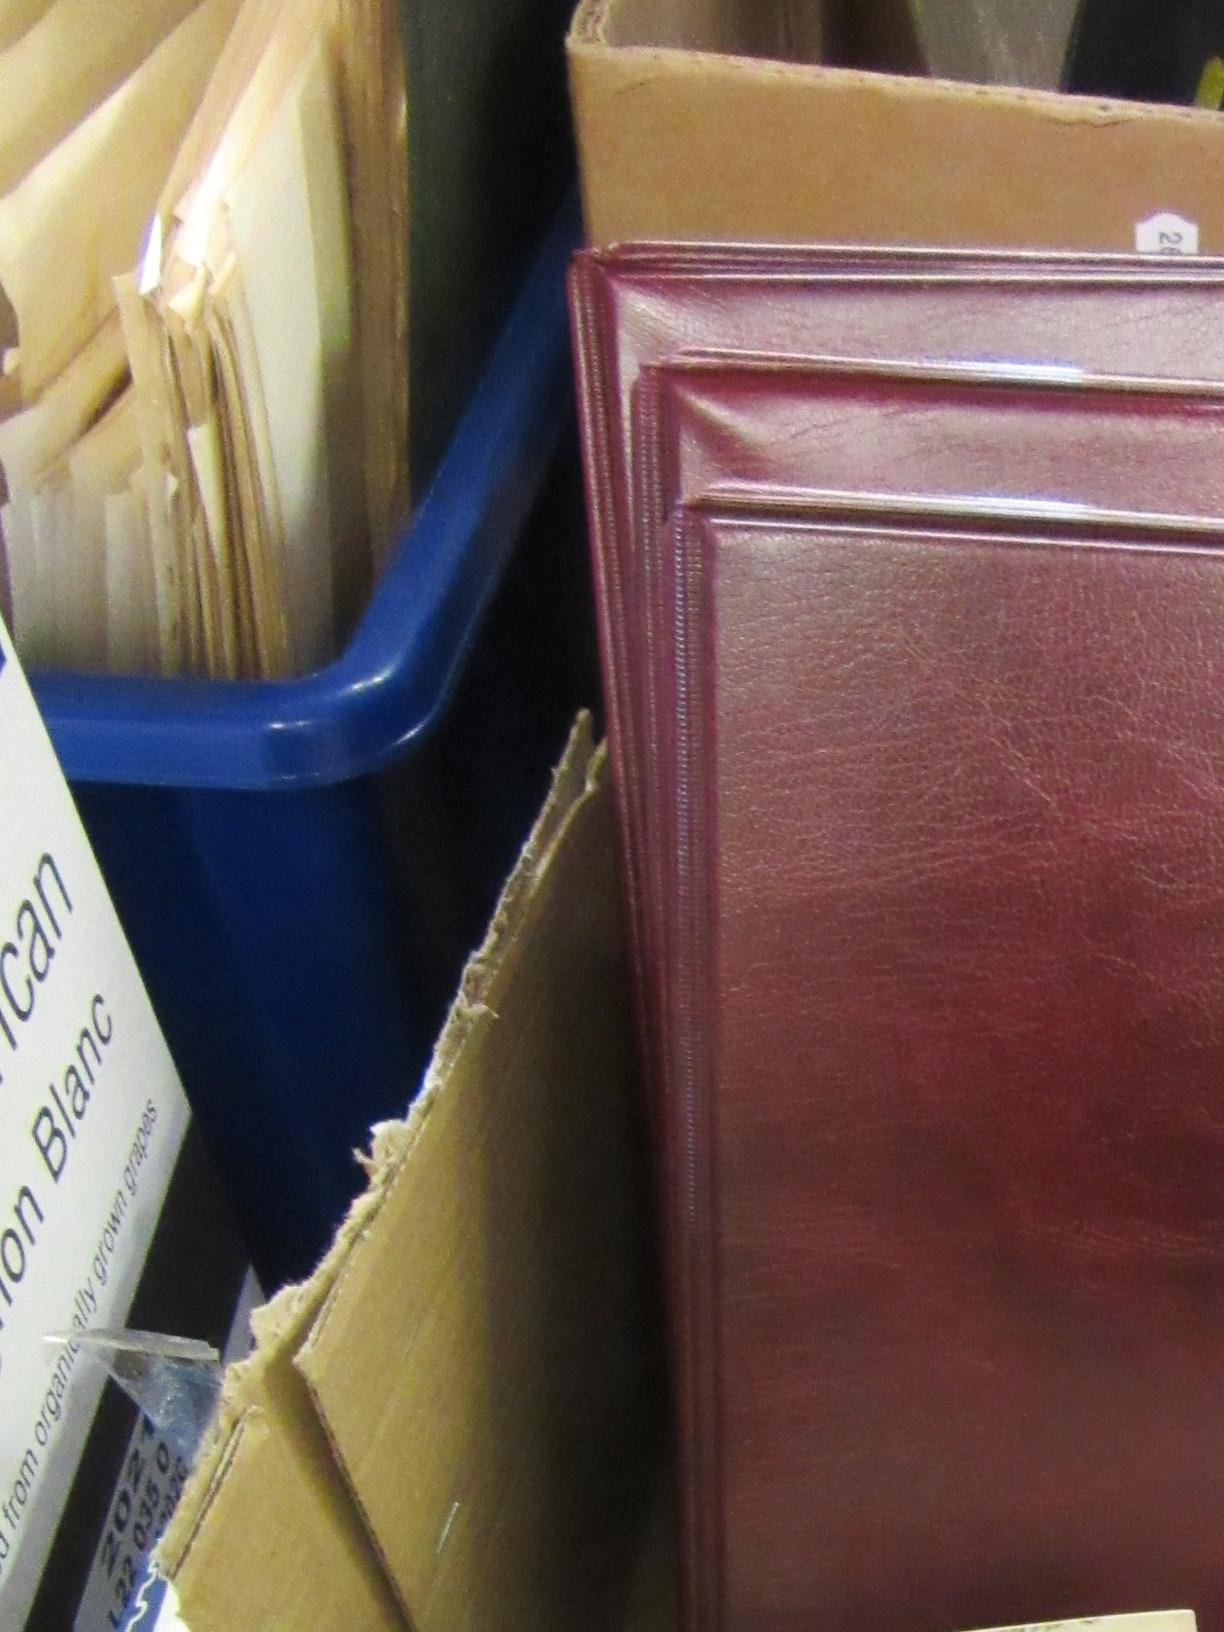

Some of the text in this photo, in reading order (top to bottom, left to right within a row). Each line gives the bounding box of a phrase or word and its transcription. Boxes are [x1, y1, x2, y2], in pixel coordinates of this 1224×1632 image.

[32, 993, 112, 1184] Blanc
[2, 1448, 39, 1530] from
[93, 1188, 127, 1287] grown
[123, 1098, 158, 1196] grapes
